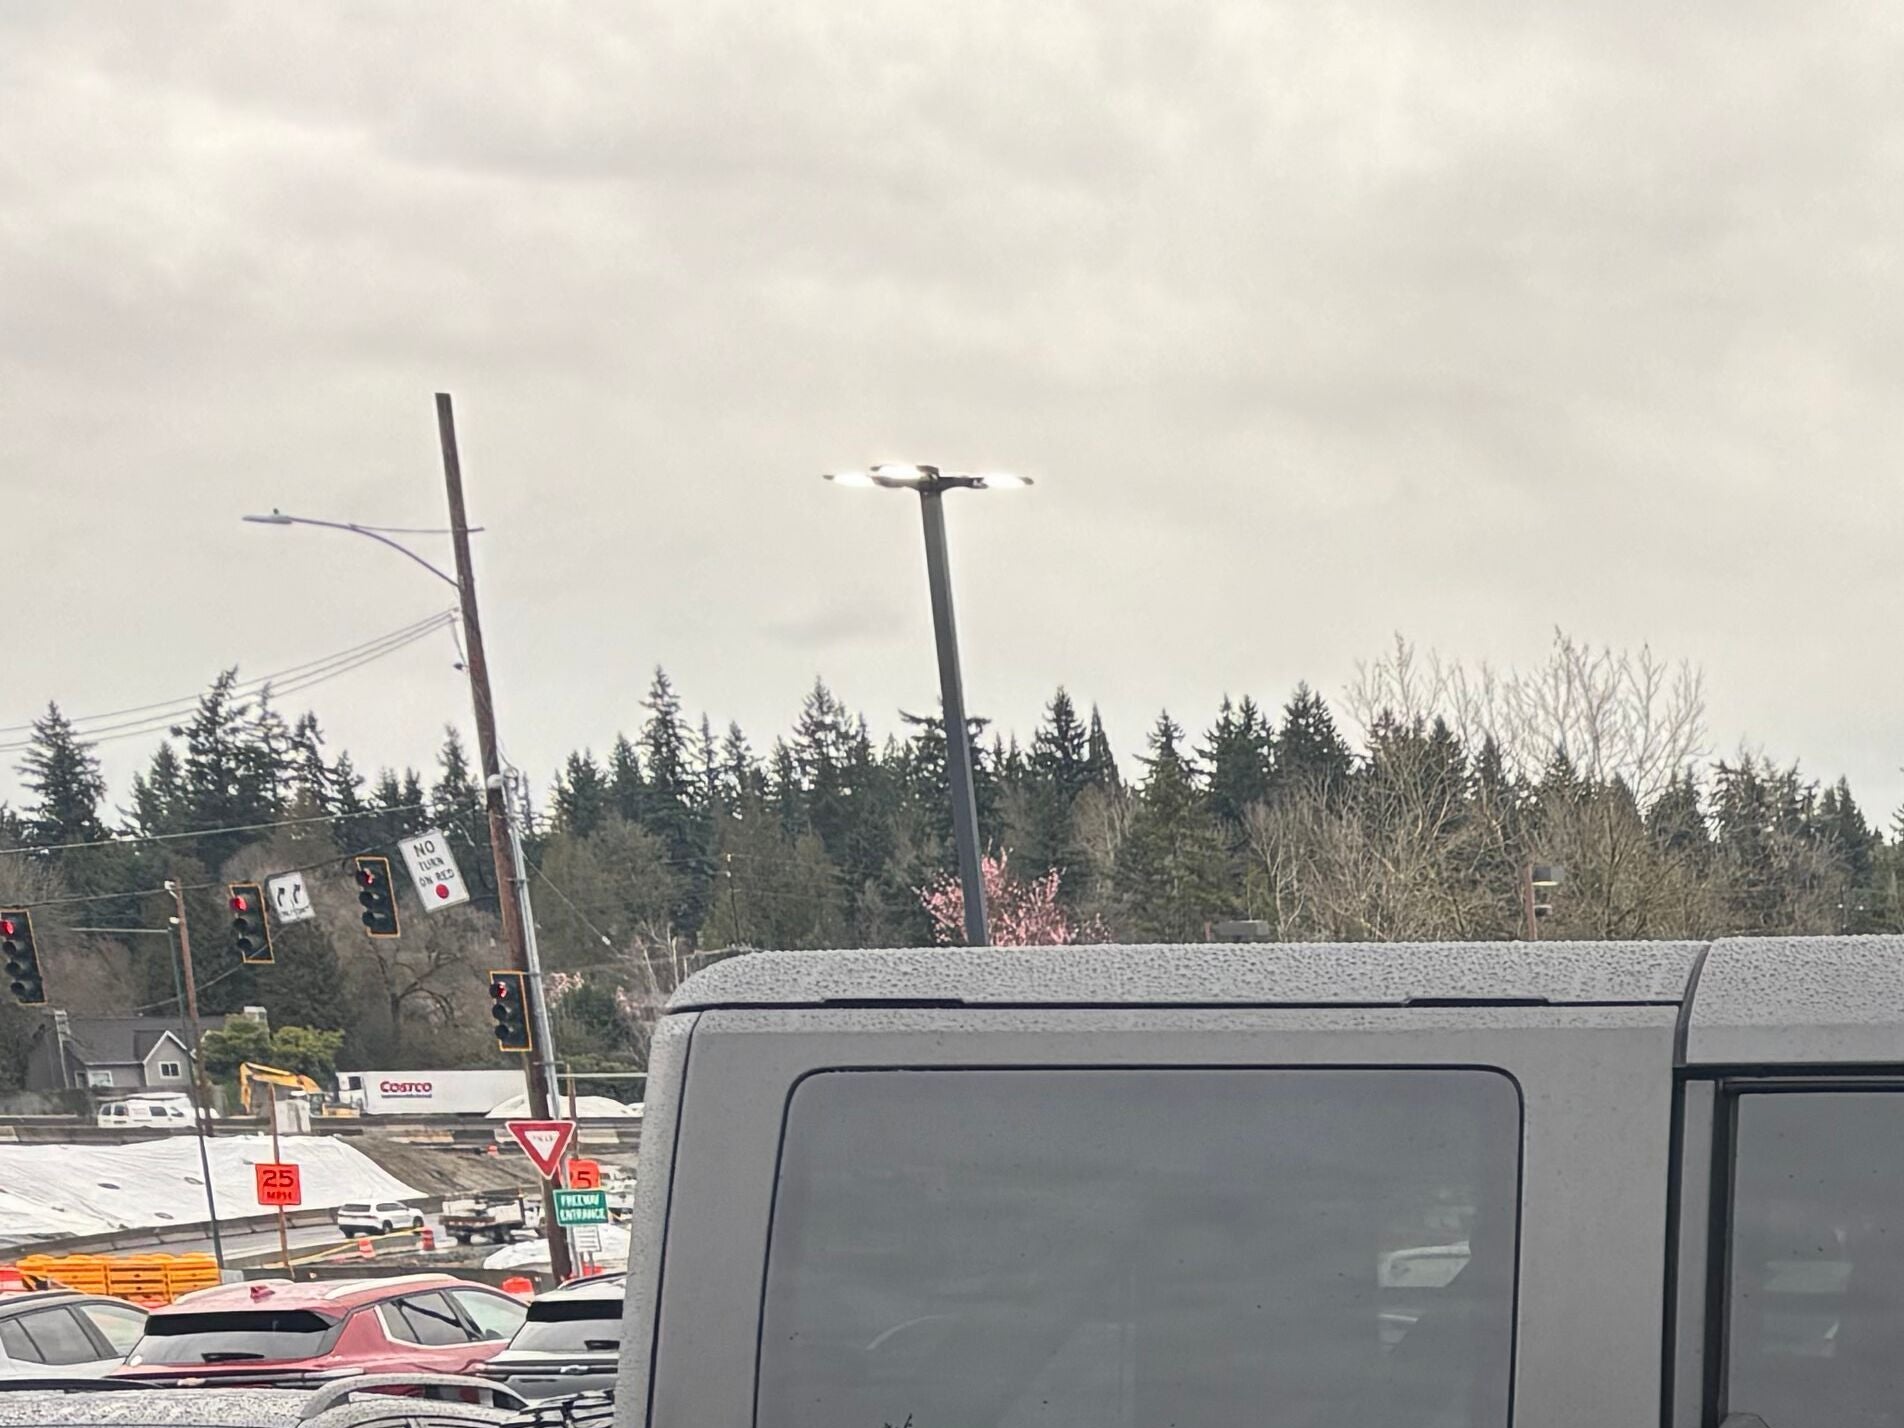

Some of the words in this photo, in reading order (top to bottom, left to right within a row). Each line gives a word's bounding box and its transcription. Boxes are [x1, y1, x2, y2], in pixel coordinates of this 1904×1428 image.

[413, 840, 436, 858] NO
[419, 857, 444, 871] TURN
[419, 876, 433, 888] ON
[435, 869, 455, 885] RED
[380, 1081, 432, 1093] COSTCO
[263, 1170, 294, 1187] 25
